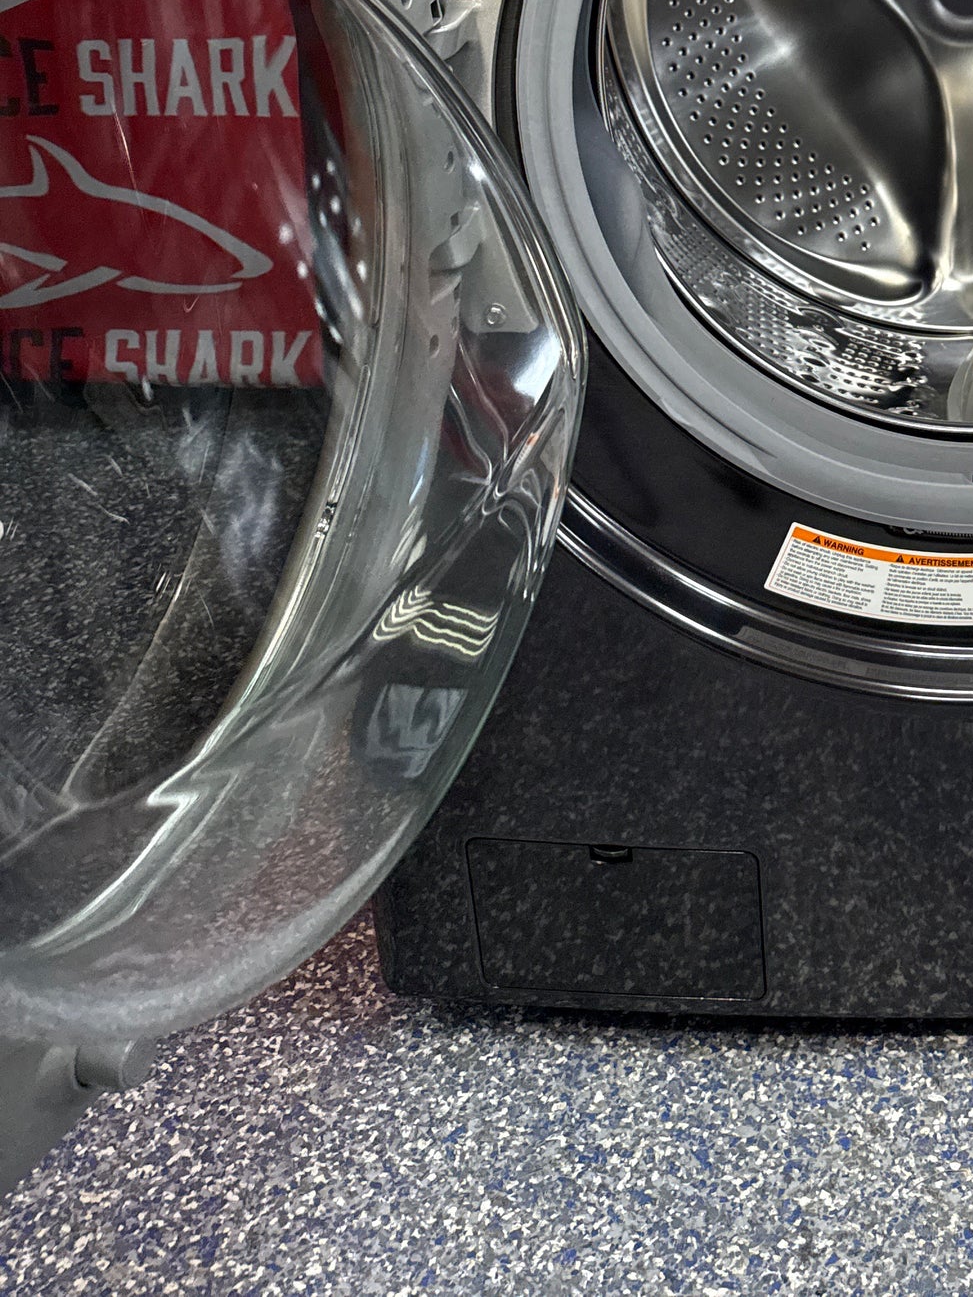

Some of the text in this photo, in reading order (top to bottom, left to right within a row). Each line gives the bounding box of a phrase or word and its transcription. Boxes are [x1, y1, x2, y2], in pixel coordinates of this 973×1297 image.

[76, 35, 299, 118] SHARK
[104, 328, 312, 388] SHARK
[824, 538, 864, 556] WARNING
